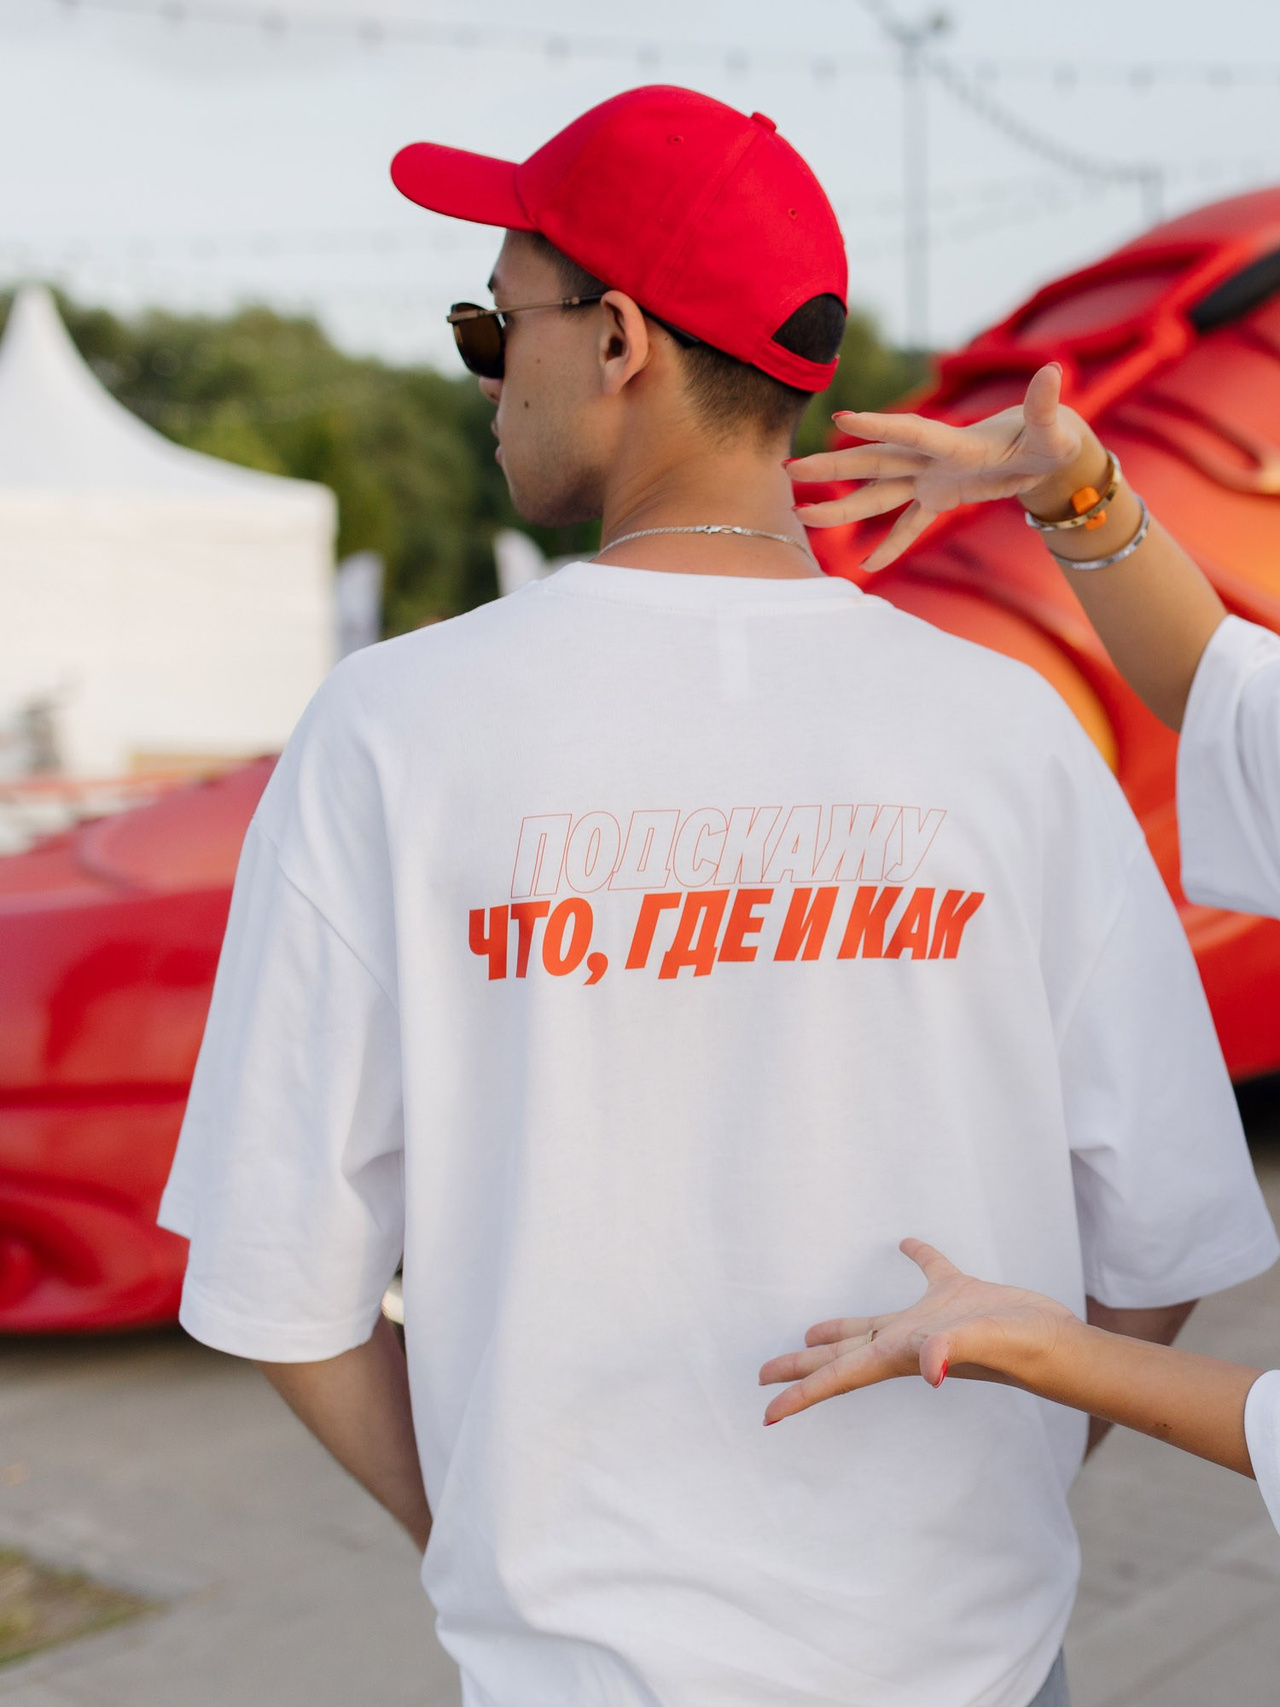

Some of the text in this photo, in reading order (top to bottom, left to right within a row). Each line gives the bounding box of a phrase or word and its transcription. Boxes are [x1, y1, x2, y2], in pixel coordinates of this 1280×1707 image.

[510, 804, 948, 899] ПОДСКАЖУ
[468, 887, 985, 986] ЧТО, ГДЕ И КАК
